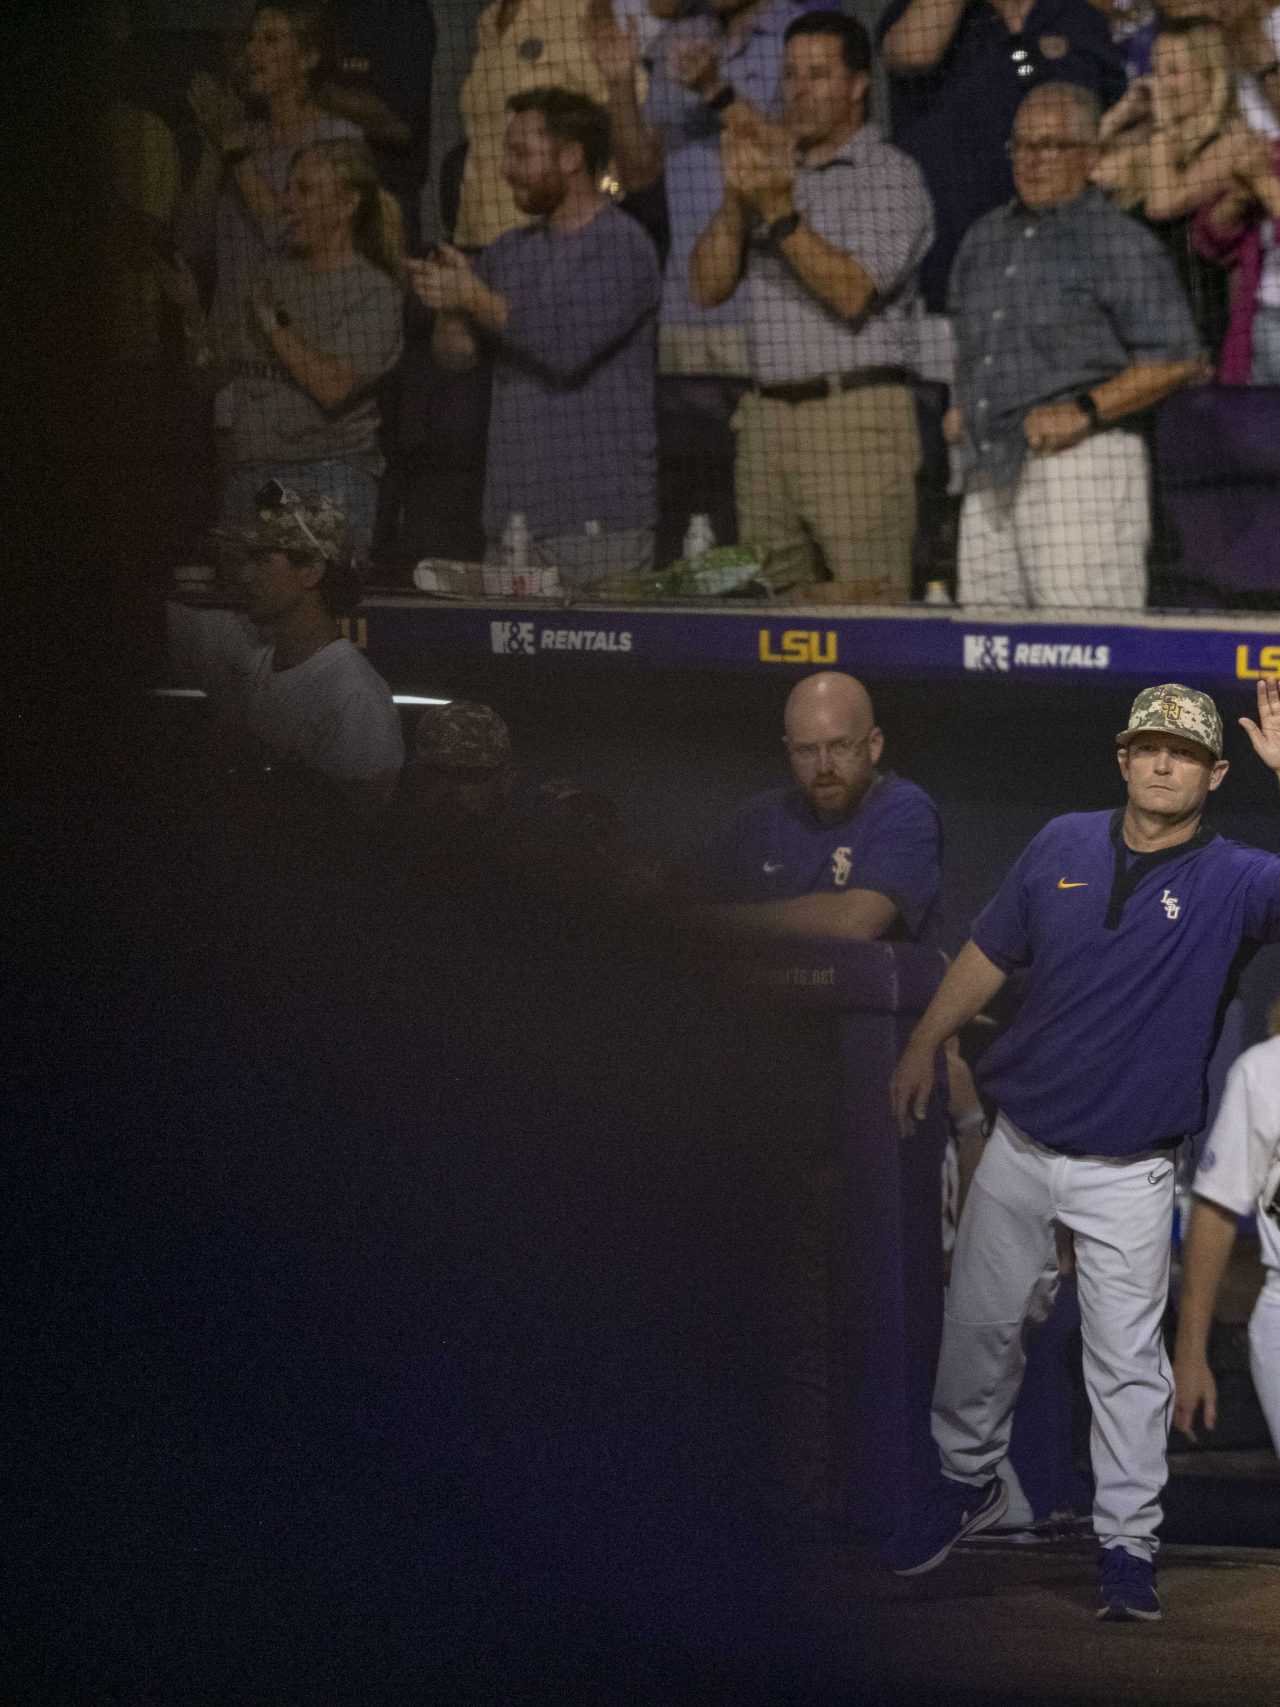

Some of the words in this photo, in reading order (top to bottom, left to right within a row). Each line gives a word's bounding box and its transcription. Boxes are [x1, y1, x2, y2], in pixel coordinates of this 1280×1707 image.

[540, 630, 632, 651] RENTALS
[759, 629, 837, 664] LSU
[1014, 643, 1110, 669] RENTALS
[1159, 688, 1184, 721] LSU
[1160, 889, 1181, 919] LSU
